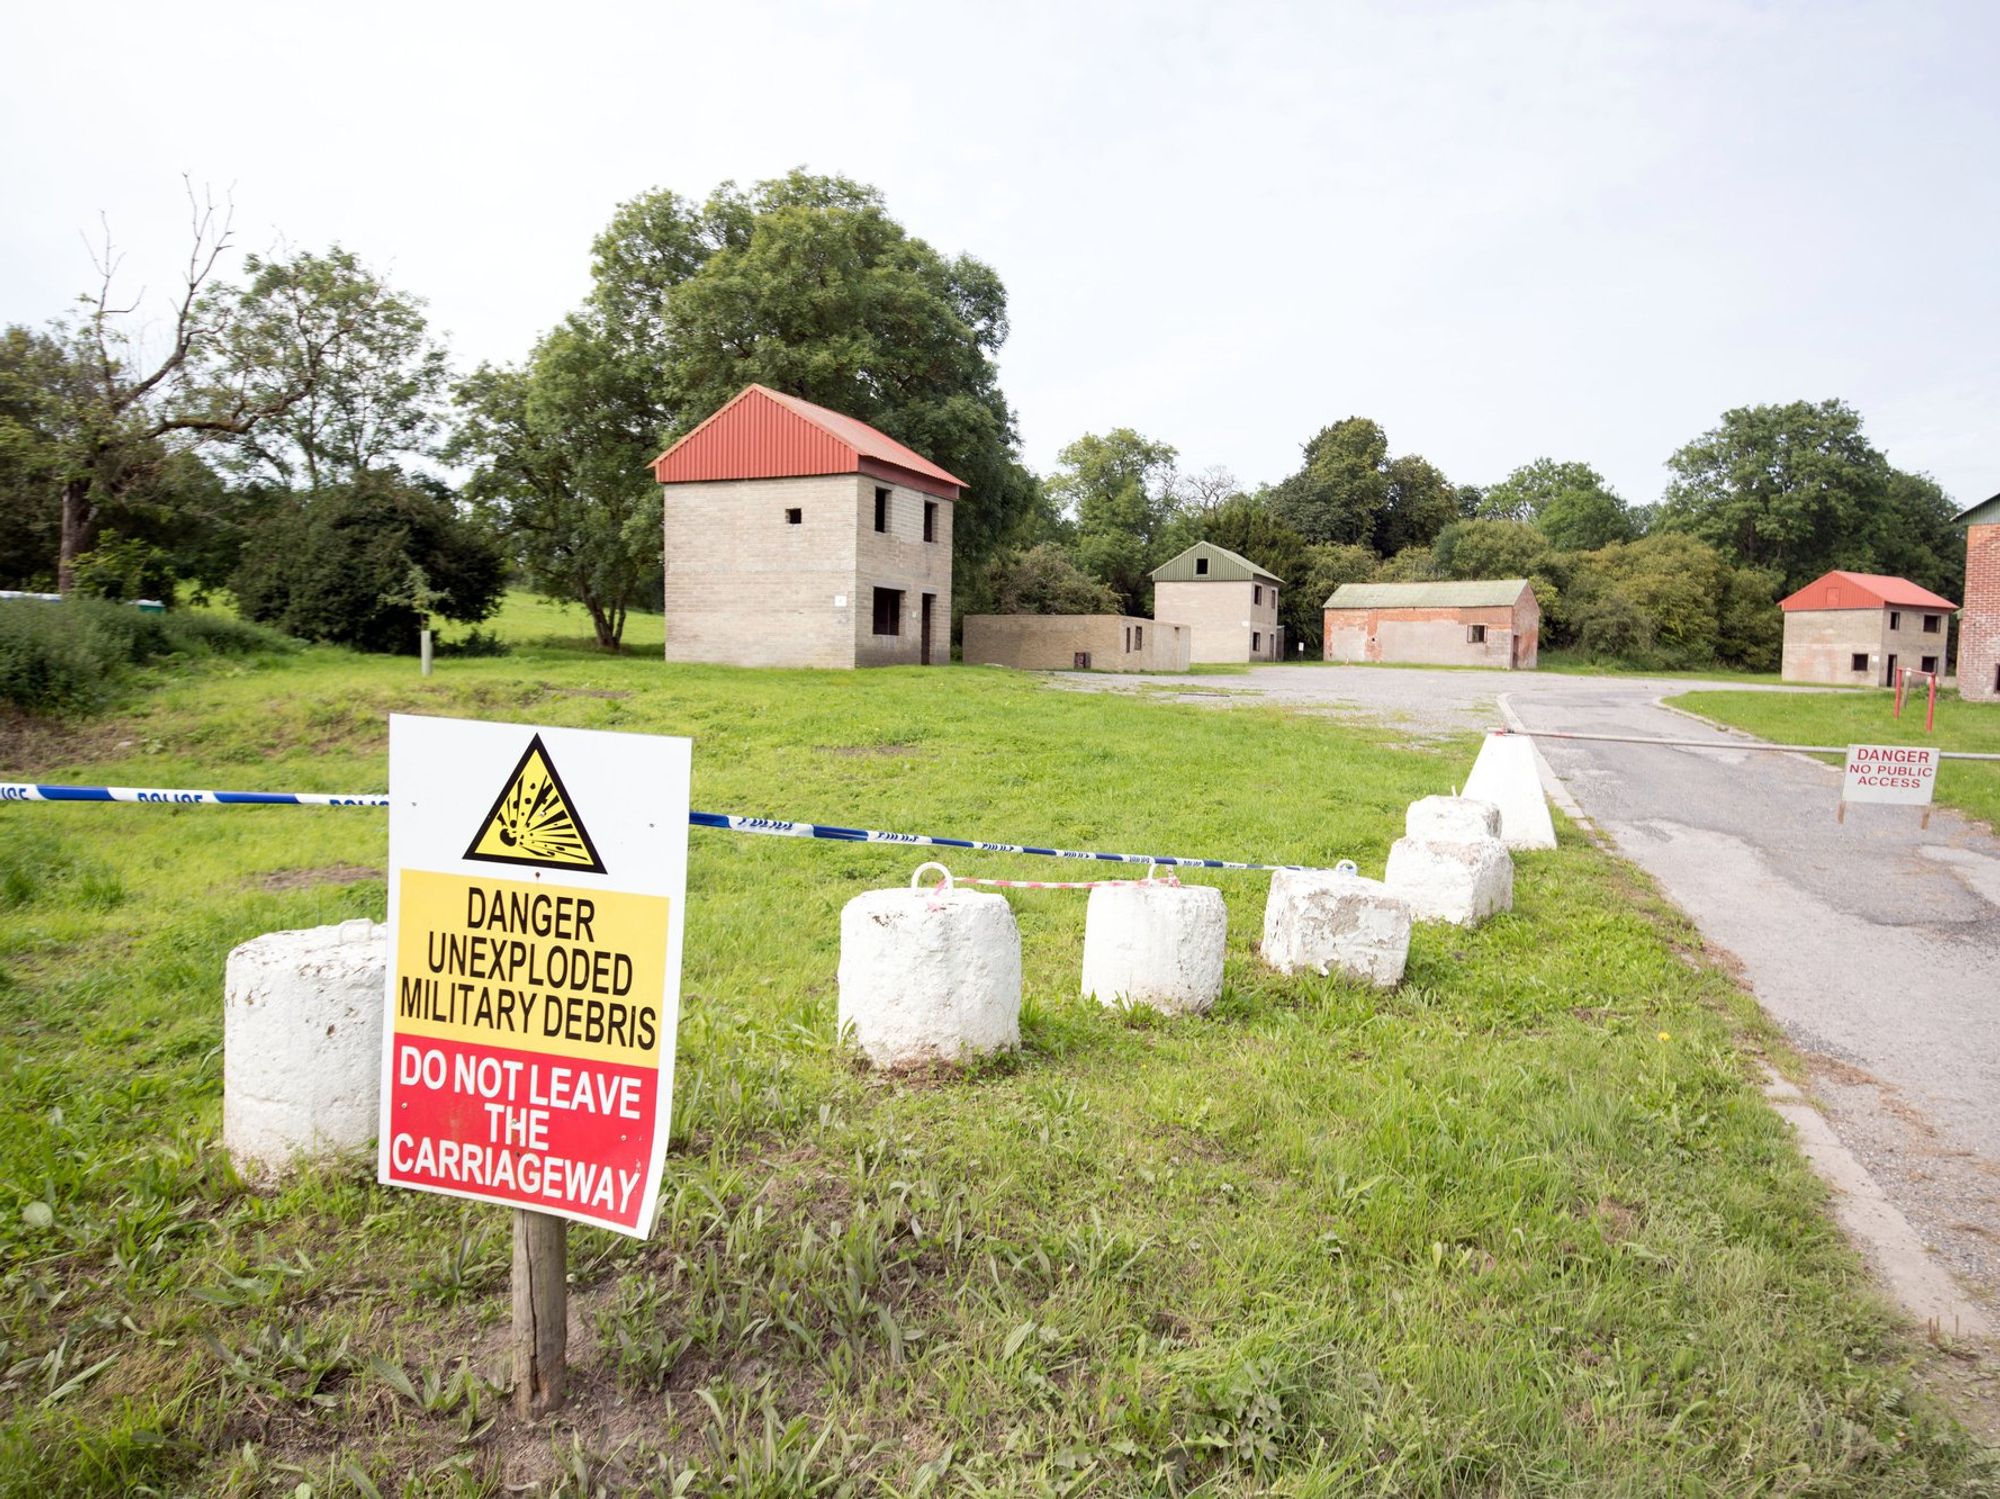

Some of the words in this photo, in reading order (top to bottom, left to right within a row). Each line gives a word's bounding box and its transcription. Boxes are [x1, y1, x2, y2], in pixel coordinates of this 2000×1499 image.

[1849, 764, 1871, 774] NO
[1877, 765, 1932, 777] PUBLIC
[1857, 748, 1929, 763] DANGER
[1857, 776, 1921, 788] ACCESS
[467, 886, 596, 943] DANGER
[428, 931, 633, 997] UNEXPLODED
[400, 976, 538, 1034] MILITARY
[543, 994, 657, 1051] DEBRIS
[399, 1045, 448, 1091] DO
[454, 1053, 524, 1101] NOT
[529, 1064, 642, 1120] LEAVE
[484, 1102, 550, 1151] THE
[392, 1132, 641, 1215] CARRIAGEWAY
